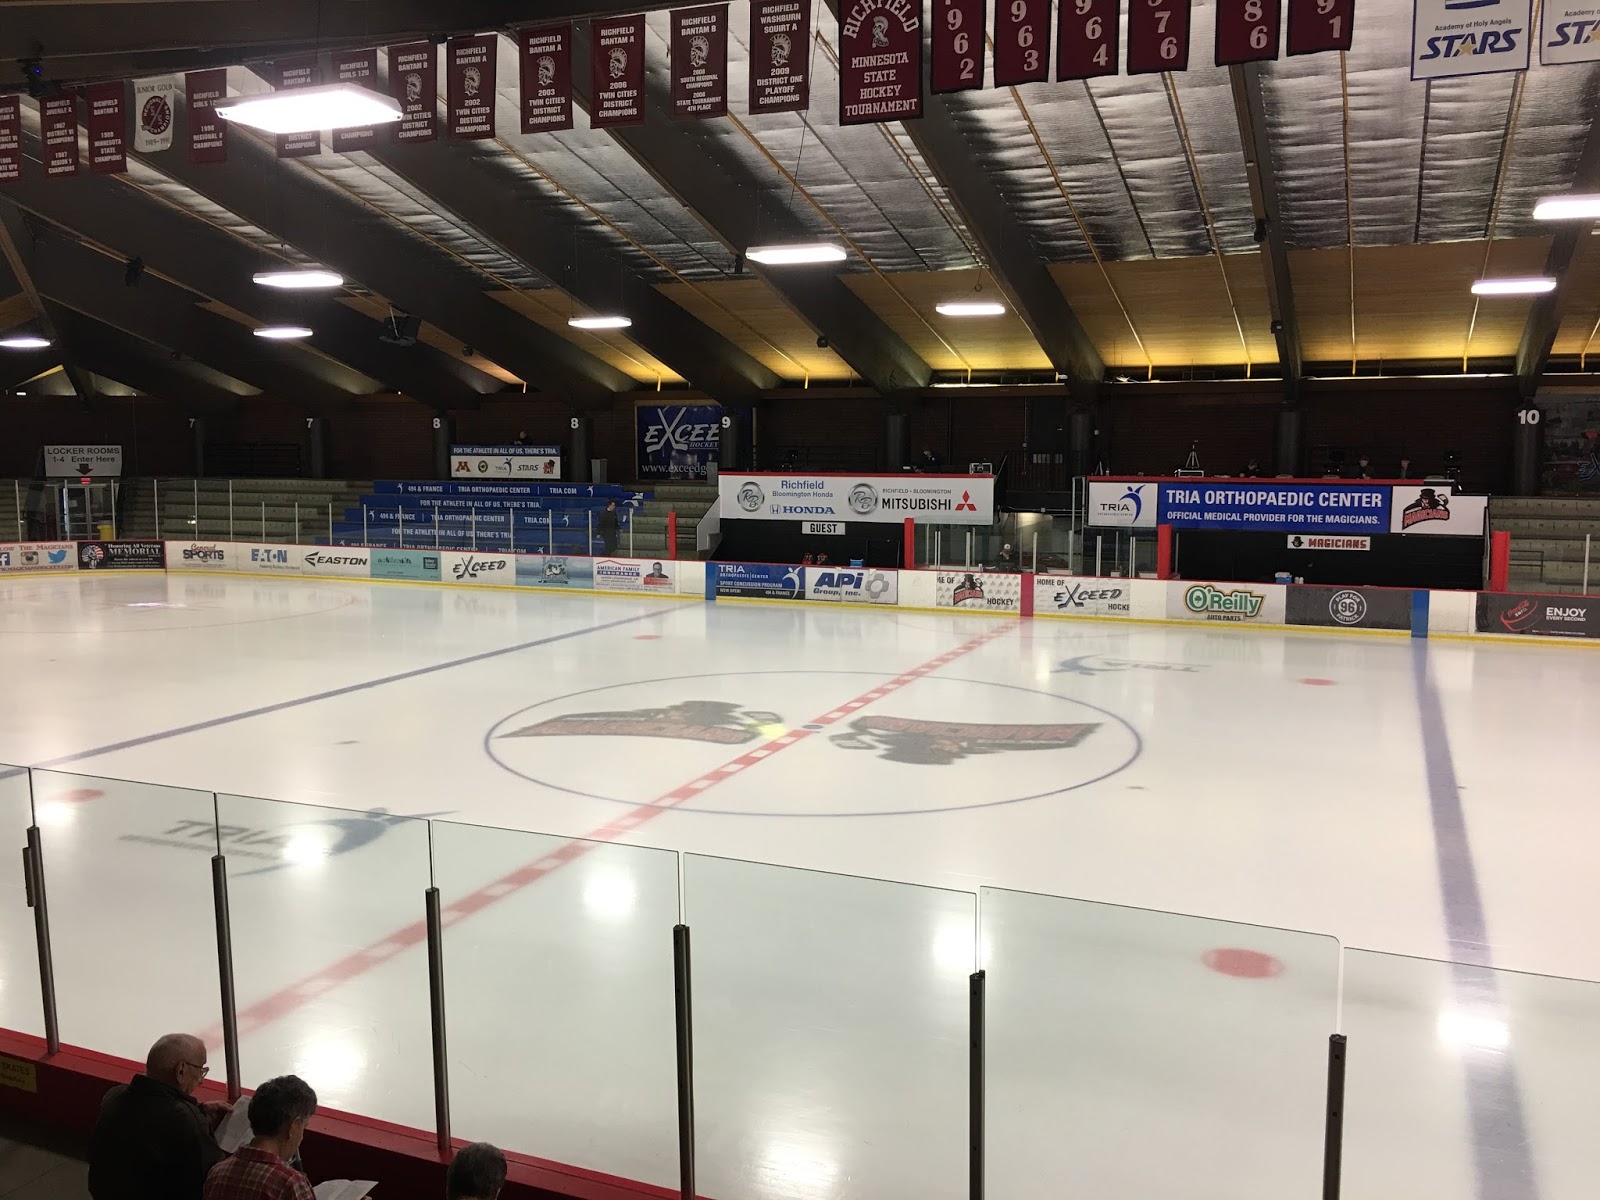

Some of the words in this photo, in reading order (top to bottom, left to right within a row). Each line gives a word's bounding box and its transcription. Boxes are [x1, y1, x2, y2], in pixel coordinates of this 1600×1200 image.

[762, 3, 799, 14] RICHFIELD
[760, 12, 801, 24] WASHBURN
[1564, 10, 1595, 18] Academy
[681, 15, 716, 26] RICHFIELD
[1434, 23, 1464, 32] Academy
[1473, 19, 1488, 28] Holy
[1489, 18, 1512, 26] Angels
[600, 26, 635, 37] RICHFIELD
[681, 26, 710, 36] BANTAM
[764, 24, 790, 34] SQUIRT
[529, 34, 562, 45] RICHFIELD
[600, 37, 628, 46] BANTAM
[1419, 28, 1522, 60] STARS
[456, 46, 487, 57] RICHFIELD
[529, 45, 556, 54] BANTAM
[397, 53, 428, 63] RICHFIELD
[456, 56, 481, 65] BANTAM
[851, 52, 909, 69] MINNESOTA
[340, 61, 369, 71] RICHFIELD
[398, 62, 422, 72] BANTAM
[283, 68, 311, 77] RICHFIELD
[340, 70, 357, 79] GIRLS
[358, 69, 369, 77] 12U
[771, 67, 789, 76] 2009
[864, 69, 896, 83] STATE
[283, 77, 306, 86] BANTAM
[680, 76, 696, 84] SOUTH
[757, 76, 788, 86] DISTRICT
[790, 75, 803, 83] ONE
[137, 86, 156, 95] JUNIOR
[157, 83, 173, 91] GOLD
[686, 81, 713, 90] CHAMPIONS
[765, 85, 795, 95] PLAYOFF
[193, 91, 219, 100] RICHFIELD
[538, 88, 555, 97] 2003
[599, 92, 616, 100] TWIN
[616, 90, 637, 99] CITIES
[860, 85, 902, 99] HOCKEY
[464, 98, 481, 107] 2002
[529, 99, 544, 107] TWIN
[545, 96, 566, 105] CITIES
[603, 99, 633, 108] DISTRICT
[759, 94, 800, 105] CHAMPIONS
[456, 108, 471, 116] TWIN
[471, 106, 490, 115] CITIES
[533, 106, 561, 115] DISTRICT
[687, 104, 696, 112] 4TH
[845, 99, 917, 116] TOURNAMENT
[413, 111, 432, 120] CITIES
[598, 108, 637, 118] CHAMPIONS
[459, 115, 487, 125] DISTRICT
[529, 114, 566, 125] CHAMPIONS
[402, 120, 428, 130] DISTRICT
[455, 124, 490, 134] CHAMPIONS
[288, 133, 312, 141] DISTRICT
[341, 130, 374, 140] CHAMPIONS
[398, 128, 432, 139] CHAMPIONS
[193, 141, 223, 150] CHAMPIONS
[285, 141, 316, 150] CHAMPIONS
[1517, 409, 1540, 425] 10
[306, 418, 313, 428] 7
[433, 418, 441, 429] 8
[570, 418, 579, 429] 8
[721, 416, 731, 429] 9
[643, 406, 720, 453] EXCEE
[47, 447, 85, 455] LOCKER
[517, 464, 539, 472] STARS
[781, 480, 824, 489] Richfield
[423, 485, 443, 493] FRANCE
[471, 486, 508, 494] ORTHOPAEDIC
[549, 487, 577, 495] TRIA.COM
[772, 490, 811, 498] Bloomington
[812, 490, 833, 498] Honda
[1166, 489, 1200, 504] TRIA
[1204, 490, 1314, 507] ORTHOPAEDIC
[1318, 492, 1382, 508] CENTER
[503, 501, 526, 509] THERE'S
[881, 498, 951, 510] MITSUBISHI
[1100, 503, 1130, 511] TRIA
[782, 506, 835, 514] HONDA
[1167, 511, 1202, 520] OFFICIAL
[1203, 511, 1241, 521] MEDICAL
[1243, 513, 1286, 522] PROVIDER
[1288, 514, 1305, 523] FOR
[1306, 514, 1323, 523] THE
[1325, 515, 1380, 525] MAGICIANS.
[810, 523, 838, 533] GUEST
[190, 543, 216, 551] General
[1308, 538, 1367, 549] MAGICIANS
[183, 549, 225, 560] SPORTS
[317, 556, 368, 566] EASTON
[452, 555, 506, 580] EXCEED
[718, 564, 745, 573] TRIA
[814, 572, 864, 589] APi
[1036, 578, 1055, 586] HOME
[813, 588, 841, 596] Group,
[1053, 583, 1123, 609] EXCEED
[987, 598, 1014, 606] HOCKEY
[1188, 586, 1263, 616] O'Reilly
[1335, 593, 1349, 602] PLAY
[1349, 593, 1361, 602] FOR
[1107, 603, 1130, 611] HOCKE
[1340, 601, 1355, 613] 96
[1546, 607, 1587, 617] ENJOY
[1336, 613, 1359, 622] PATRICK
